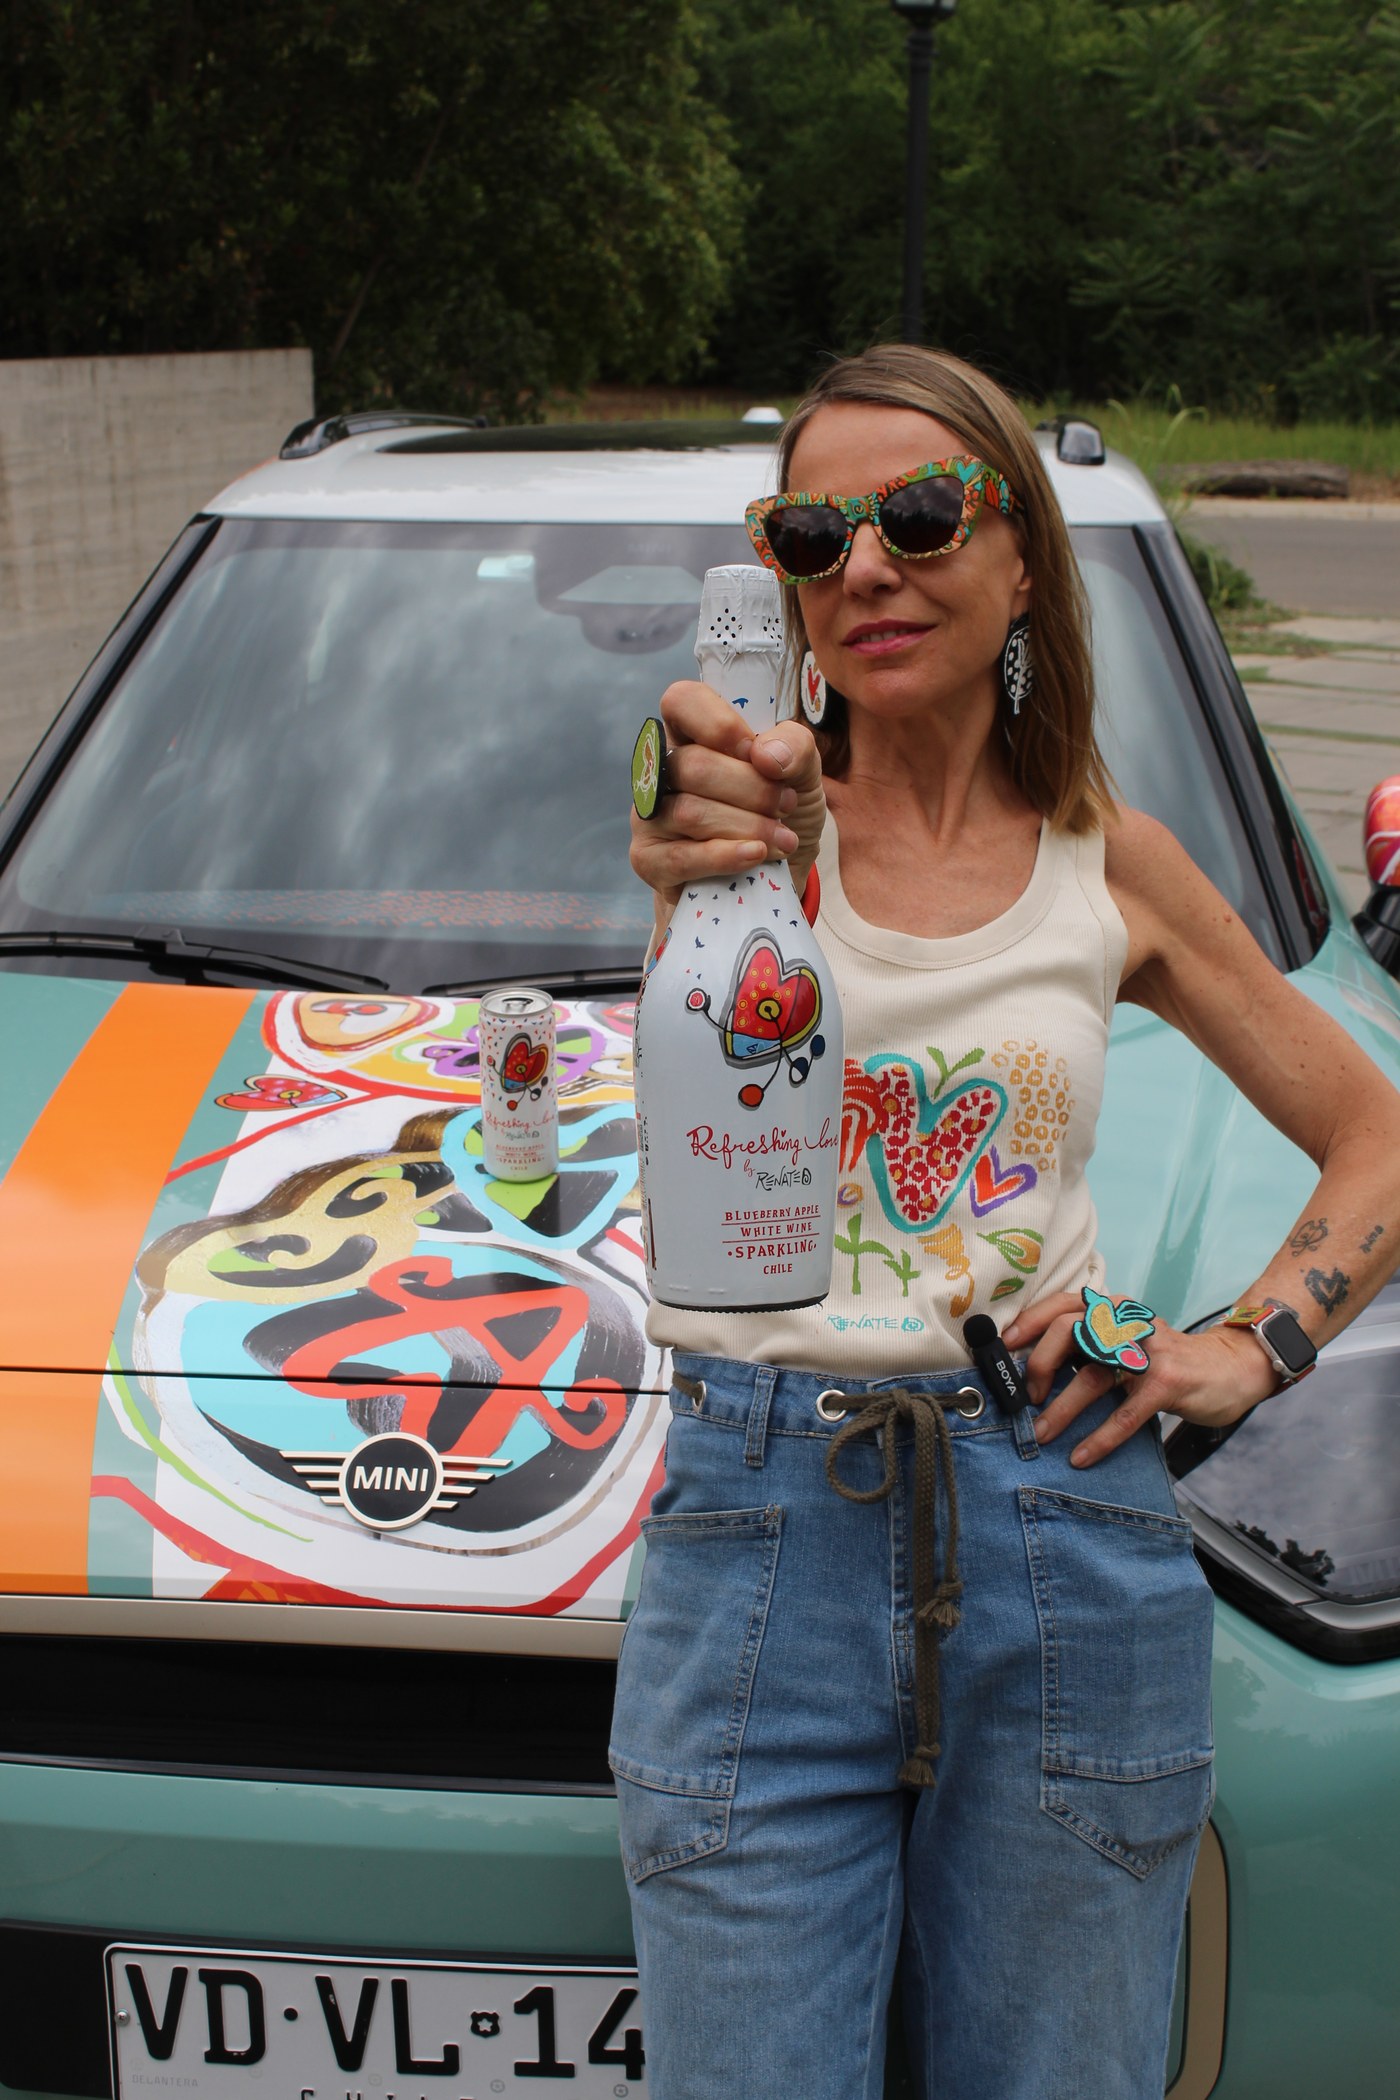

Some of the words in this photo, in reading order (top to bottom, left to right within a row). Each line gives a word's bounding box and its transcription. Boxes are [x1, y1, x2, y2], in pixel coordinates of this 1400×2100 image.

[686, 1125, 802, 1169] Refreshing
[743, 1158, 755, 1177] by
[725, 1207, 791, 1222] BLUEBERRY
[794, 1204, 820, 1217] APPLE
[740, 1224, 782, 1238] WHITE
[786, 1221, 813, 1234] WINE
[763, 1262, 793, 1275] CHILE
[995, 1359, 1018, 1397] BOYA
[353, 1465, 429, 1492] MINI
[132, 2074, 199, 2088] DELANTERA
